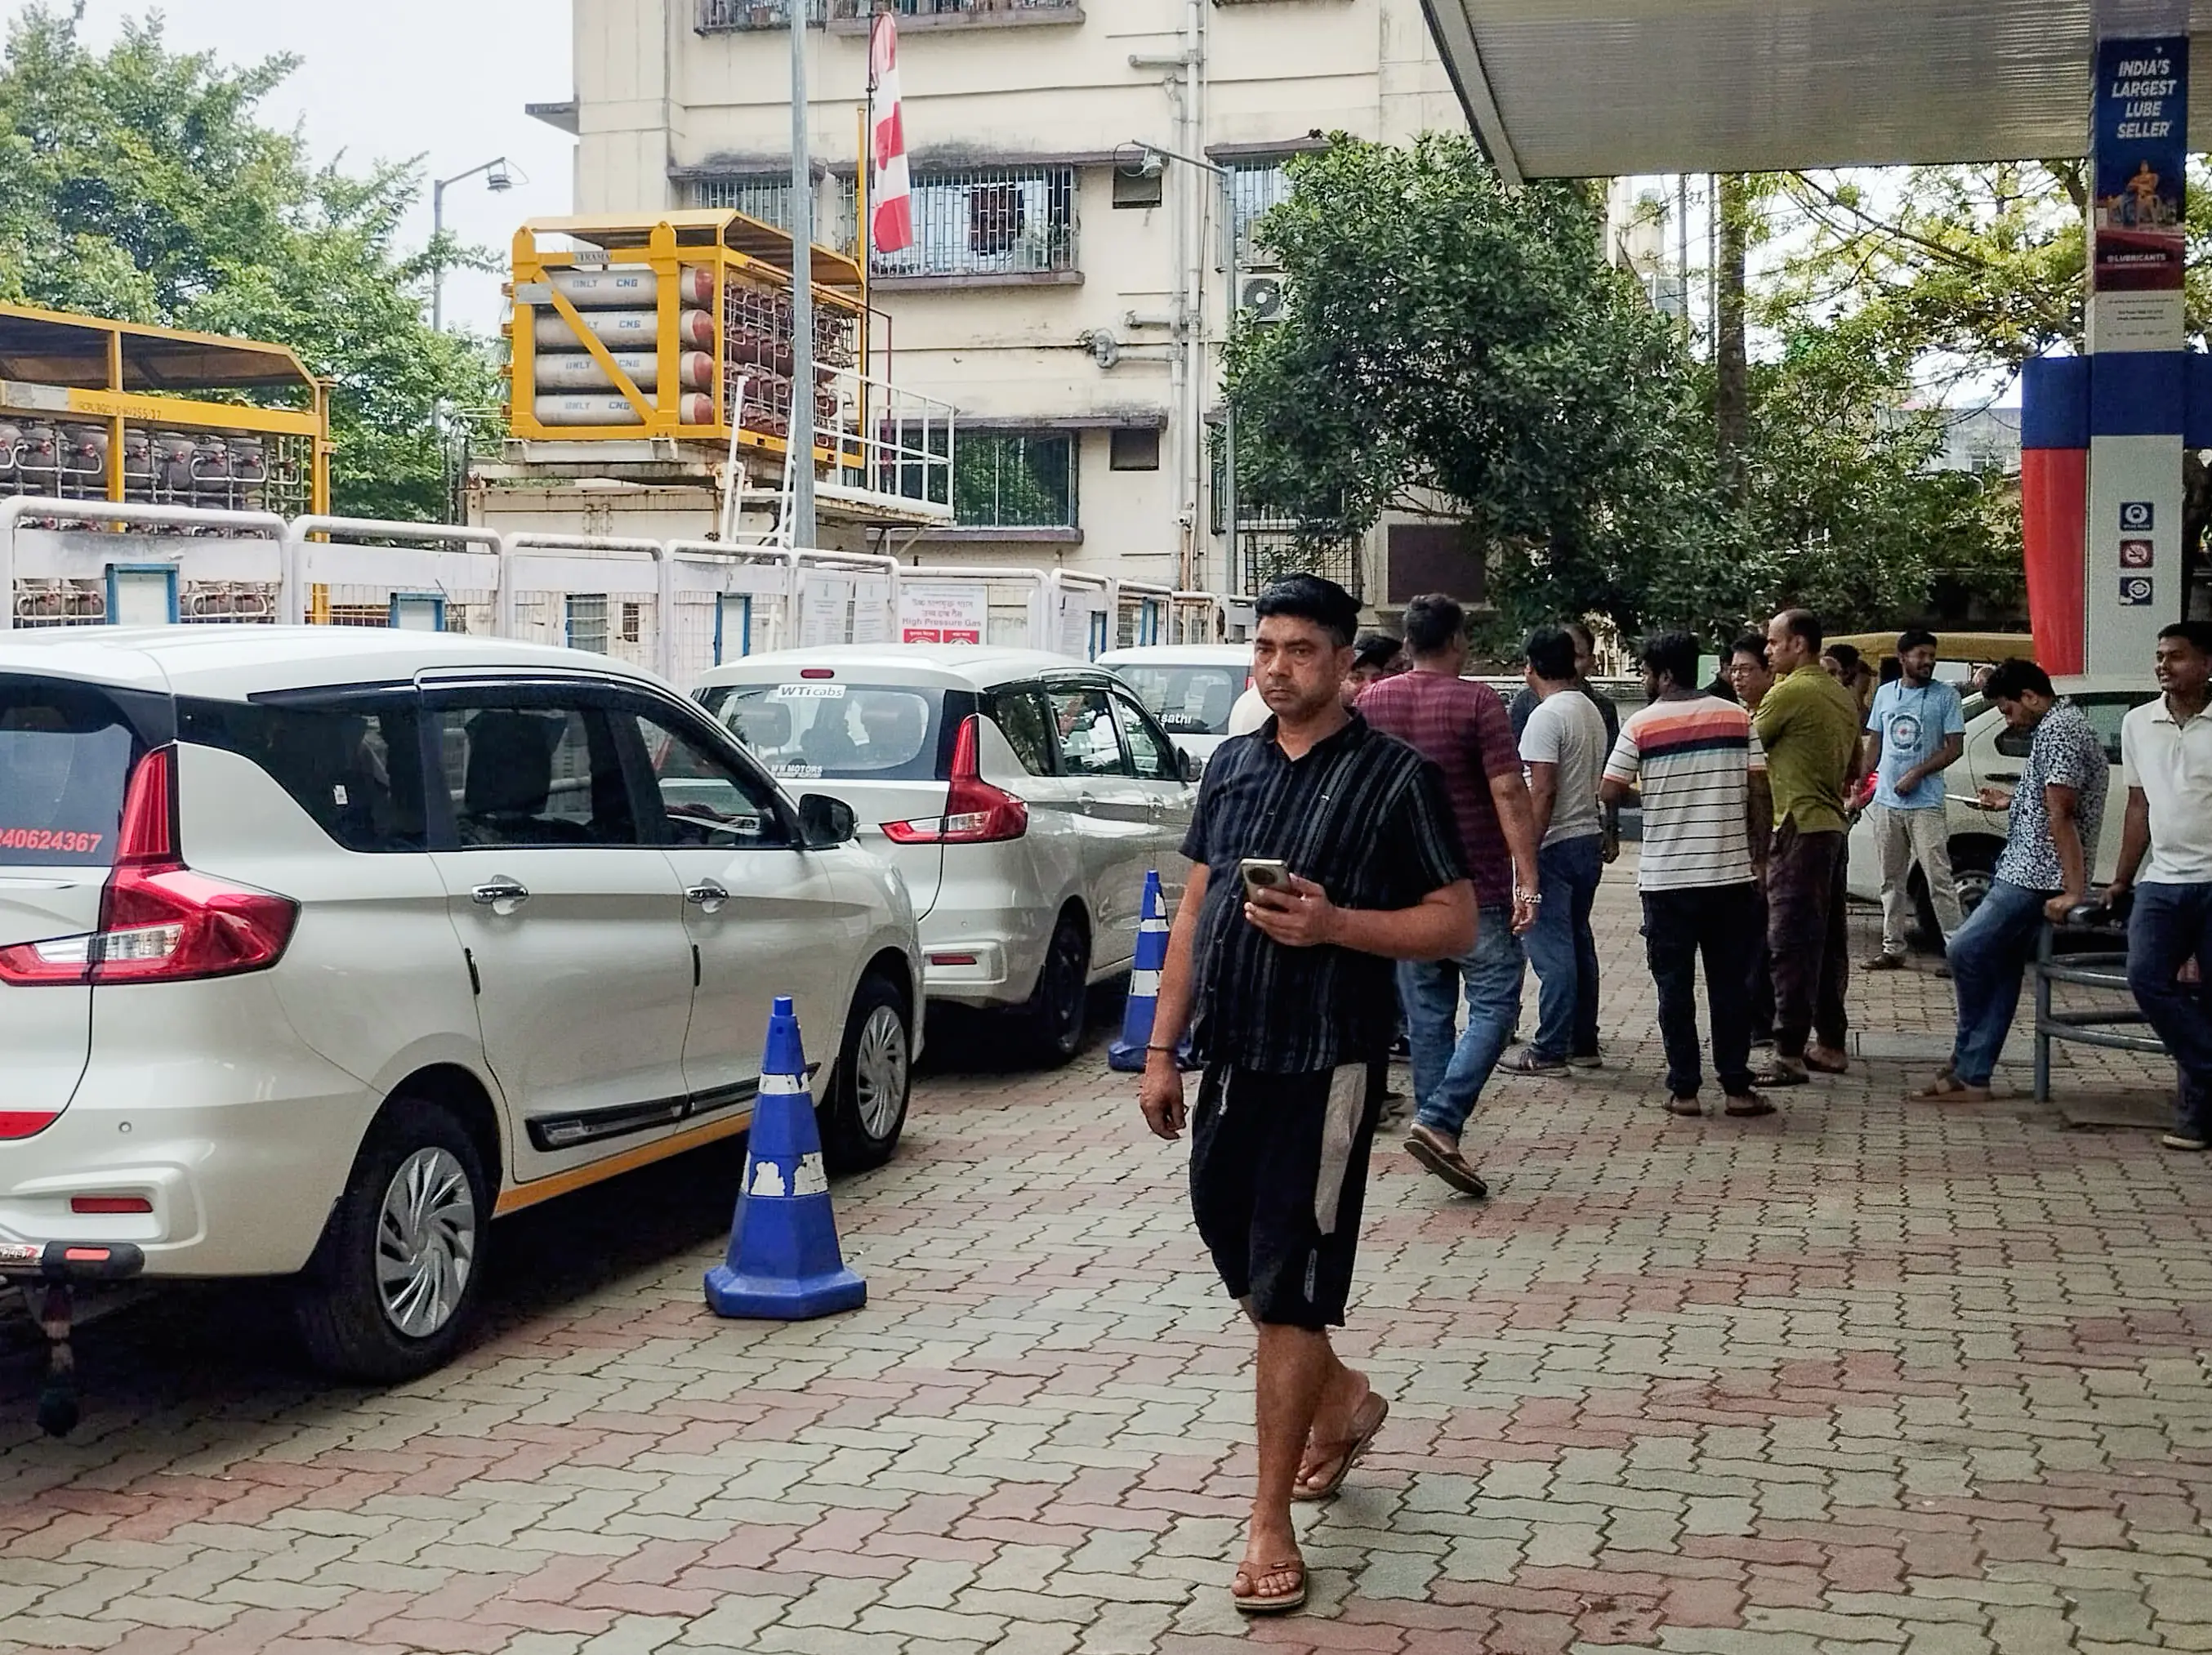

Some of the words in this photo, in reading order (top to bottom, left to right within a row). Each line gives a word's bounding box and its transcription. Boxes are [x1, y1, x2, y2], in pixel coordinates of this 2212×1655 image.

[2118, 59, 2170, 77] INDIA'S
[2112, 80, 2177, 98] LARGEST
[2125, 101, 2162, 118] LUBE
[2116, 122, 2170, 139] SELLER
[2114, 253, 2166, 261] LUBRICANTS
[617, 279, 638, 288] CNG
[619, 319, 641, 328] CNG
[618, 359, 640, 368] CNG
[609, 401, 630, 410] CNG
[903, 618, 922, 627] High
[925, 618, 962, 627] Pressure
[1161, 713, 1192, 725] sathi
[787, 765, 823, 774] MOTORS
[0, 828, 102, 853] 40624367
